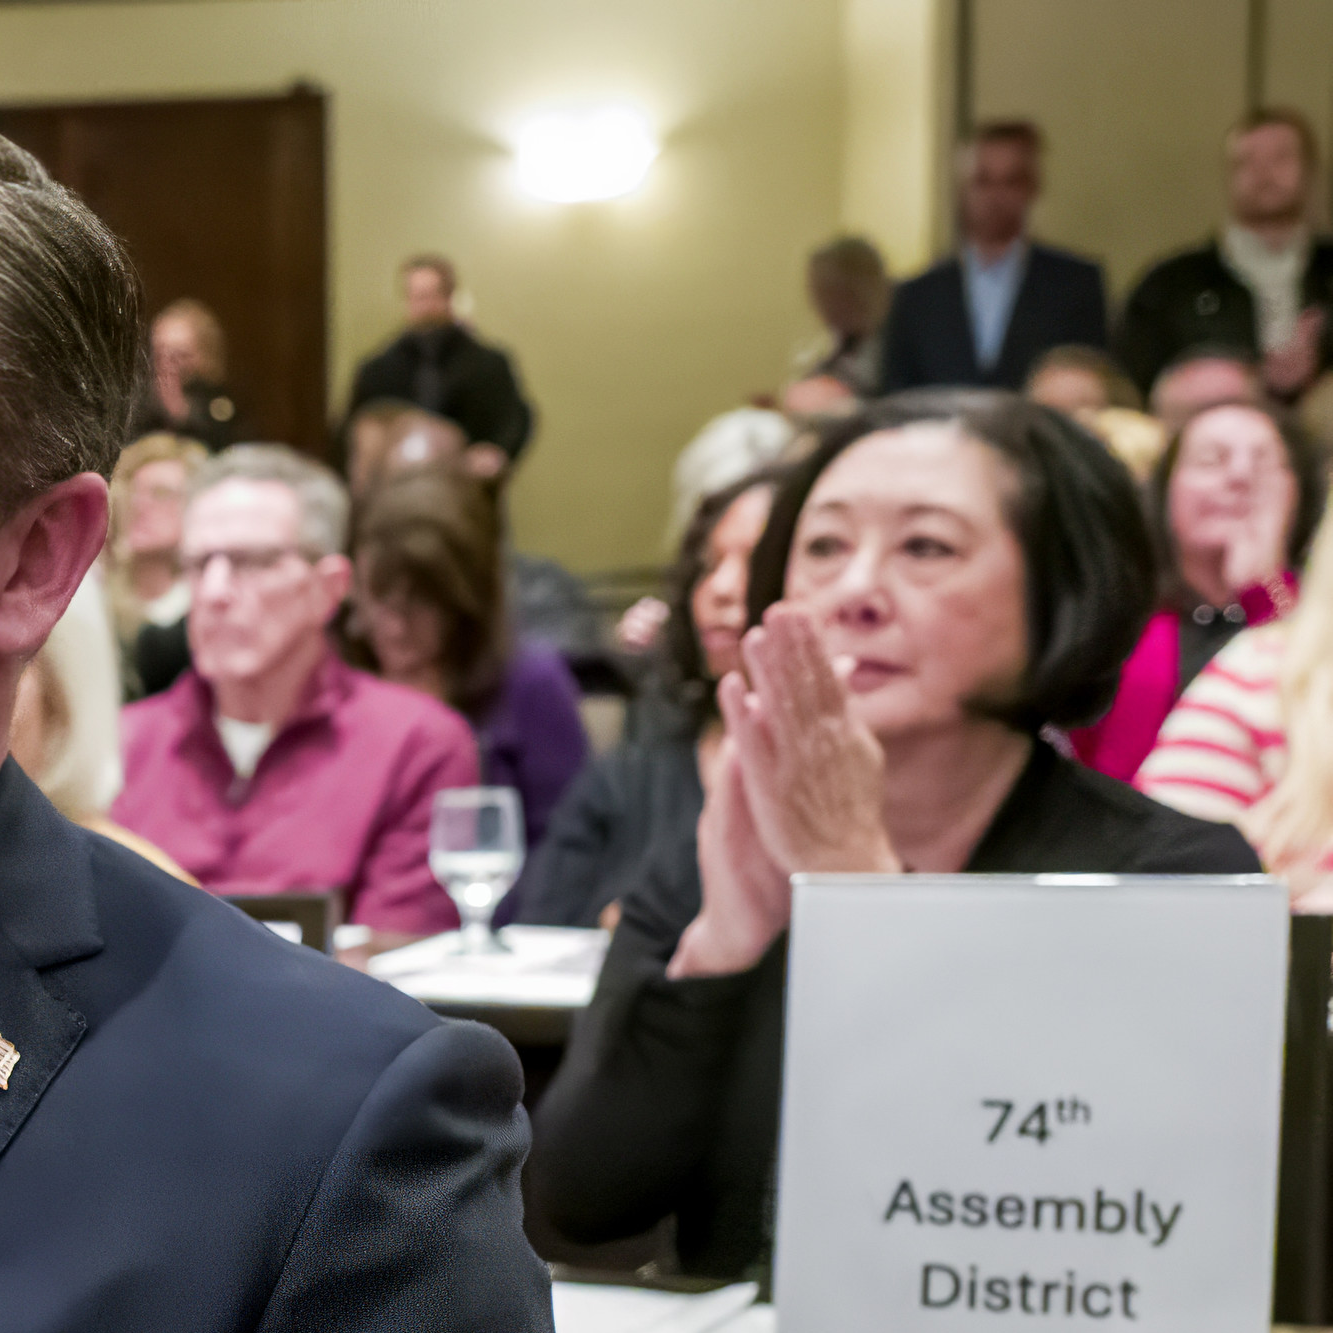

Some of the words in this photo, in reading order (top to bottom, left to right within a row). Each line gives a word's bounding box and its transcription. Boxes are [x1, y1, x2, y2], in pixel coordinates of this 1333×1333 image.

[981, 1095, 1092, 1145] 74th
[883, 1179, 1184, 1247] Assembly
[919, 1264, 1139, 1321] District
